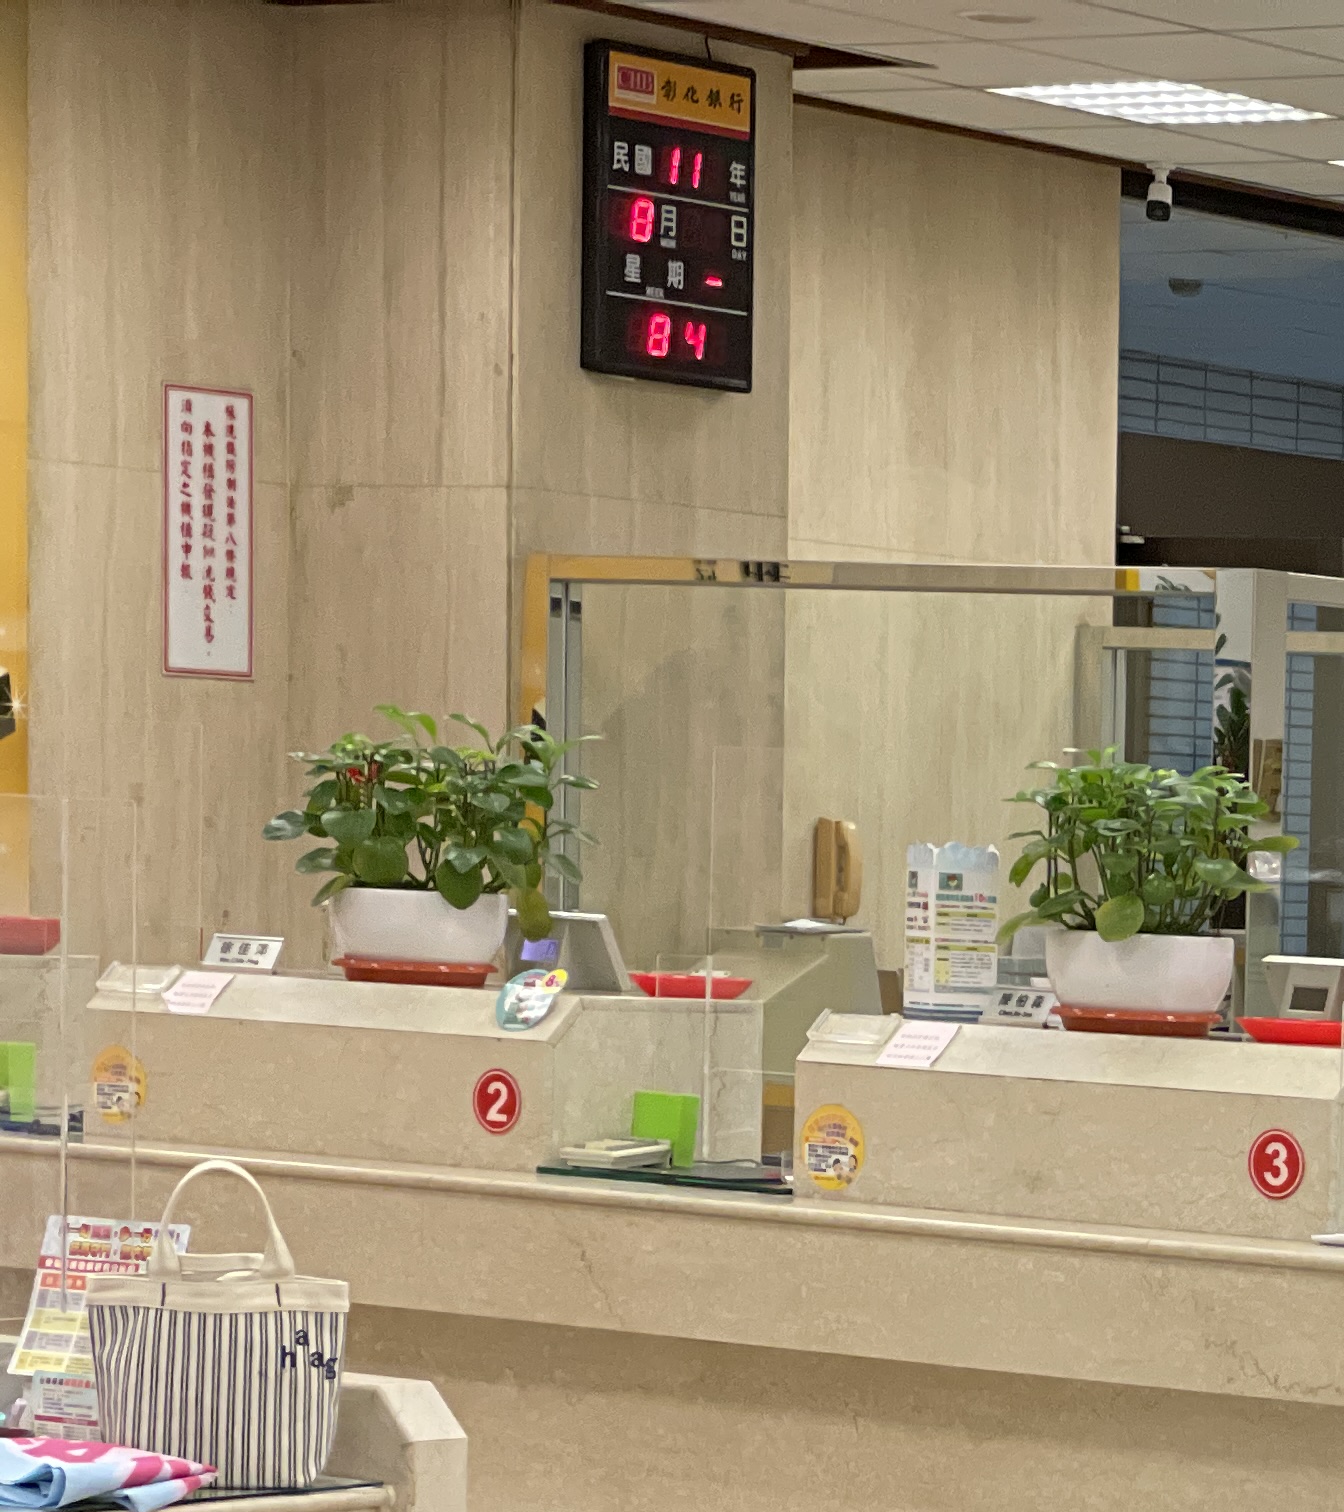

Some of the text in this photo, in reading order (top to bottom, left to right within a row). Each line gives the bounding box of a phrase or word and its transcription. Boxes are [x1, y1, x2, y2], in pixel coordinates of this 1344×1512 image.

[661, 79, 744, 114] 彰化銀行
[612, 141, 652, 176] 民國
[729, 161, 746, 188] 年
[731, 215, 747, 247] 日
[486, 1080, 508, 1123] 2
[1263, 1142, 1290, 1186] 3
